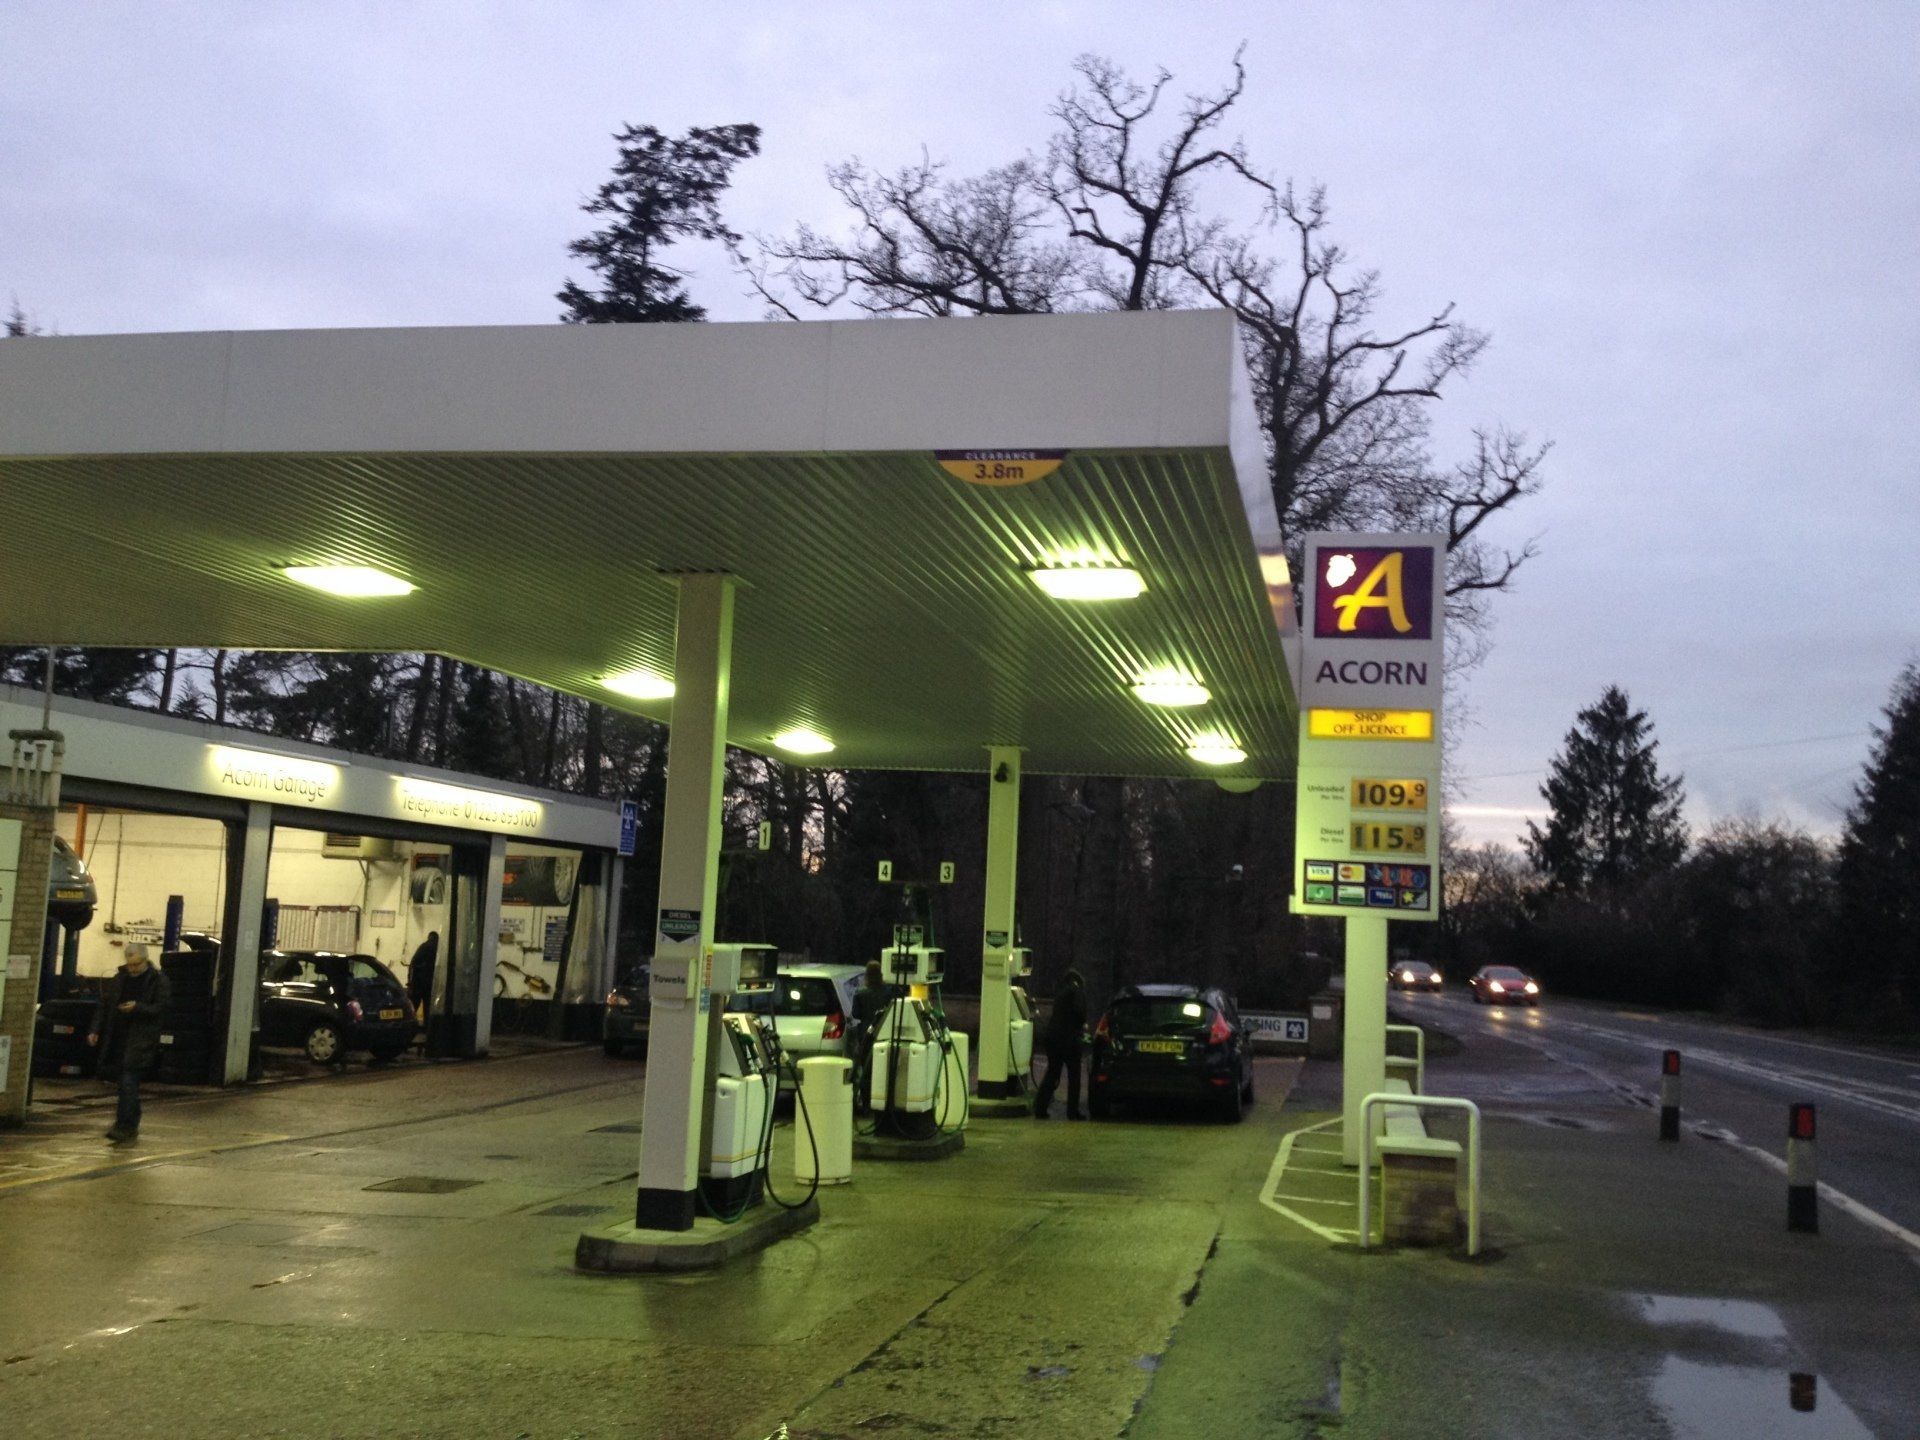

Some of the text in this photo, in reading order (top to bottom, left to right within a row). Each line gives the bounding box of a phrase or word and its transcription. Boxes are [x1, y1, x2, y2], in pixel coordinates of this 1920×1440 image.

[965, 452, 1036, 460] CLEARANCE
[974, 463, 1025, 479] 3.8m
[1333, 551, 1413, 633] A
[1316, 660, 1427, 686] ACORN
[1354, 711, 1387, 721] SHOP
[1333, 724, 1406, 735] OFF LICENCE
[222, 763, 326, 802] Acorn Garage
[1307, 784, 1345, 793] Unleaded
[1320, 827, 1344, 836] Diesel
[881, 864, 888, 878] 4
[943, 865, 951, 880] 3
[653, 974, 686, 984] Towels
